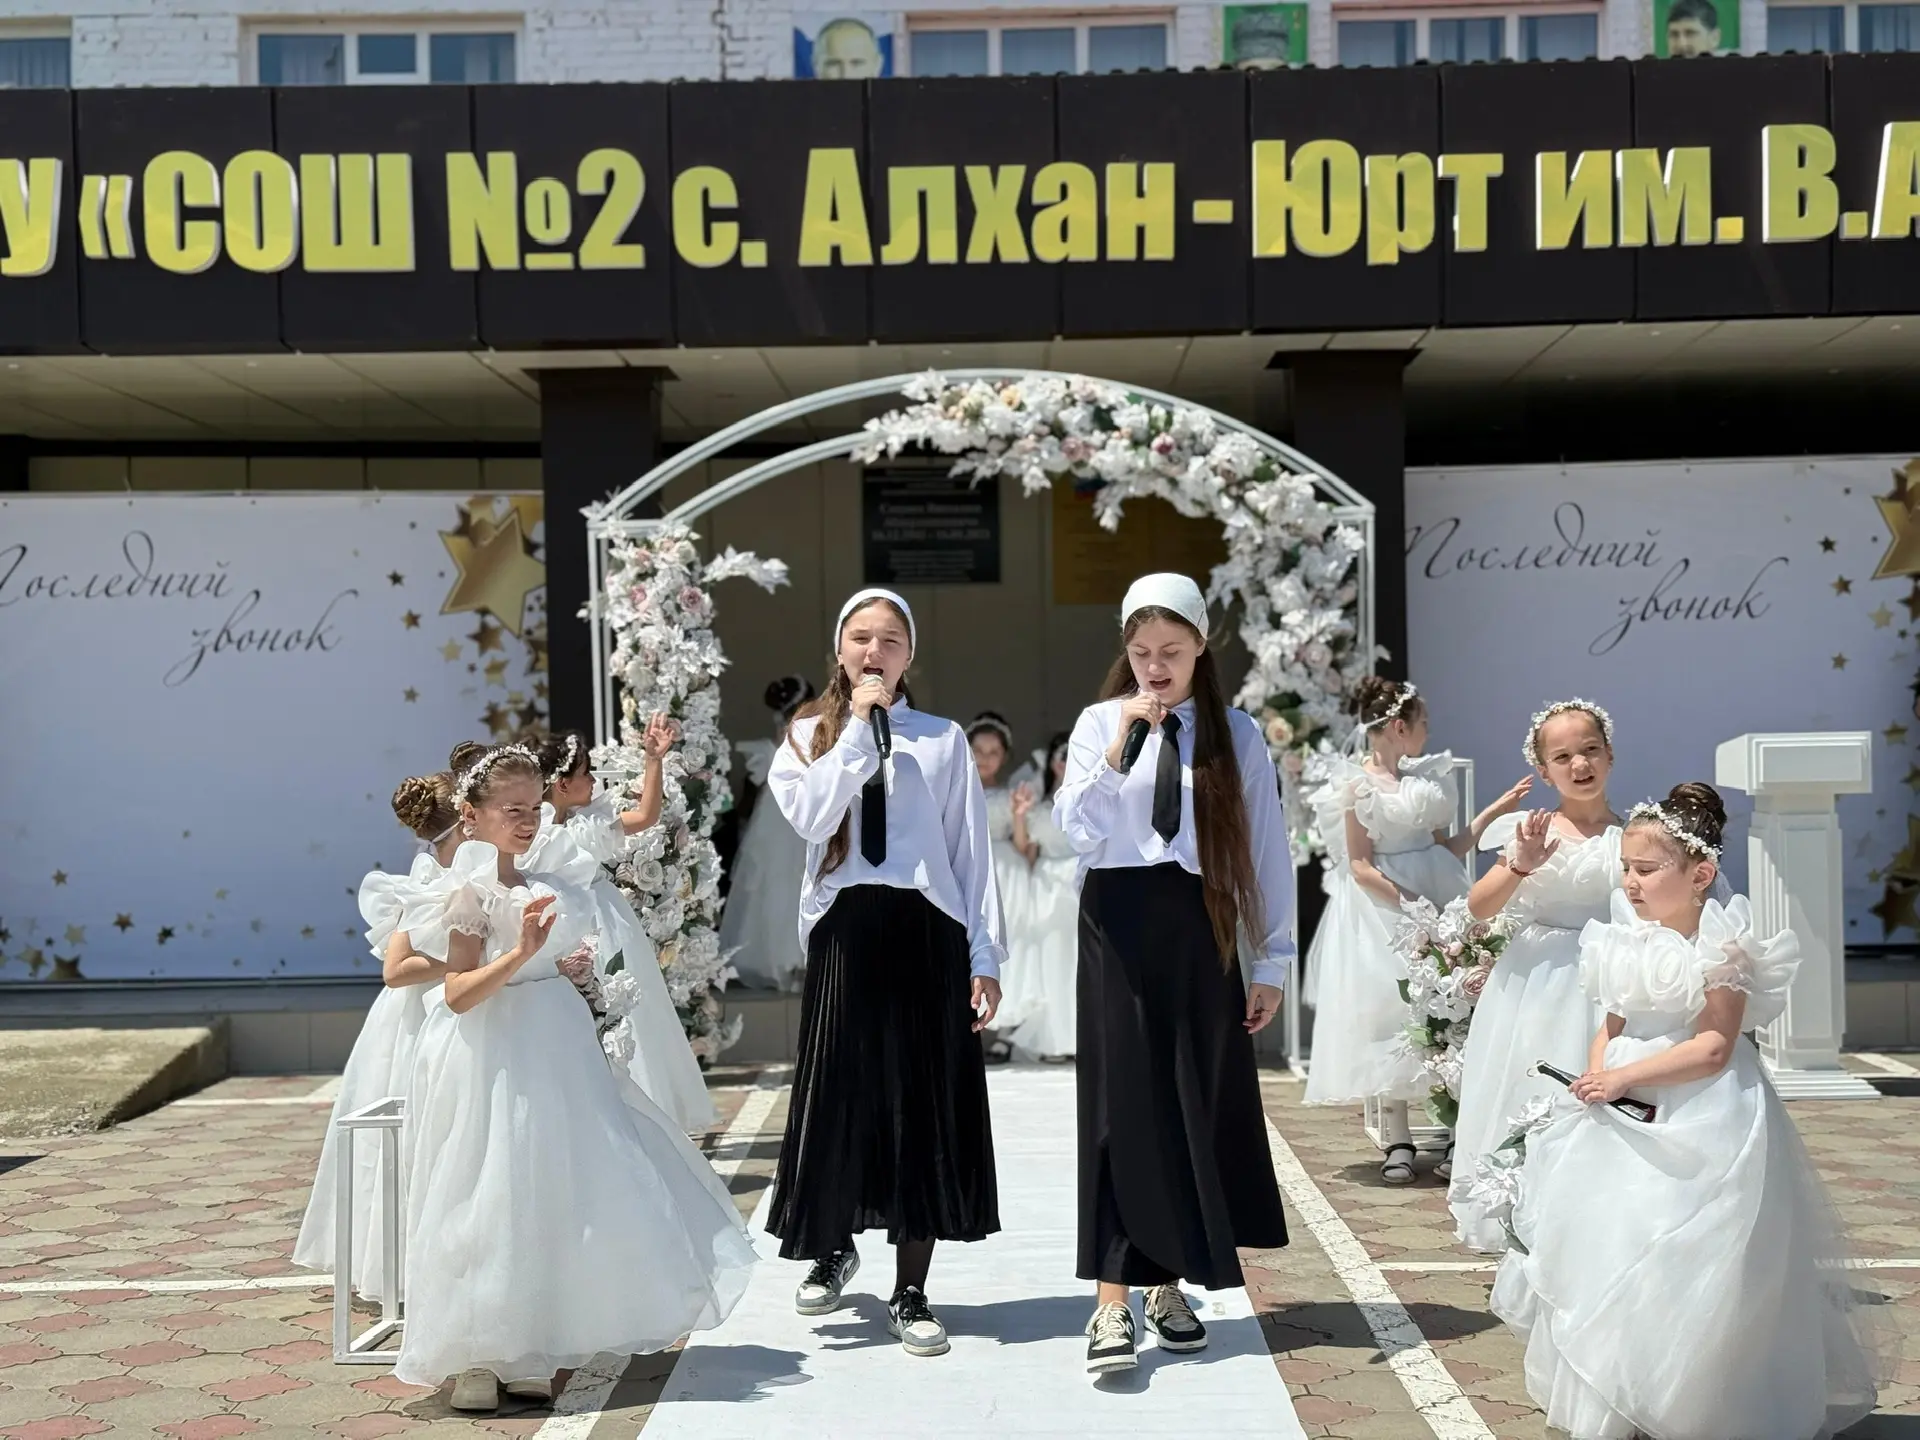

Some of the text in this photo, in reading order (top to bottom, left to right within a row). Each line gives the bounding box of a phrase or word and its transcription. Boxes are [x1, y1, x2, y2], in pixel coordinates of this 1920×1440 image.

[78, 150, 415, 274] «СОШ
[446, 147, 646, 271] №2
[671, 165, 768, 268] с.
[1534, 146, 1745, 250] им.
[1406, 502, 1662, 580] Последний
[162, 589, 360, 688] звонок
[1588, 558, 1789, 656] звонок
